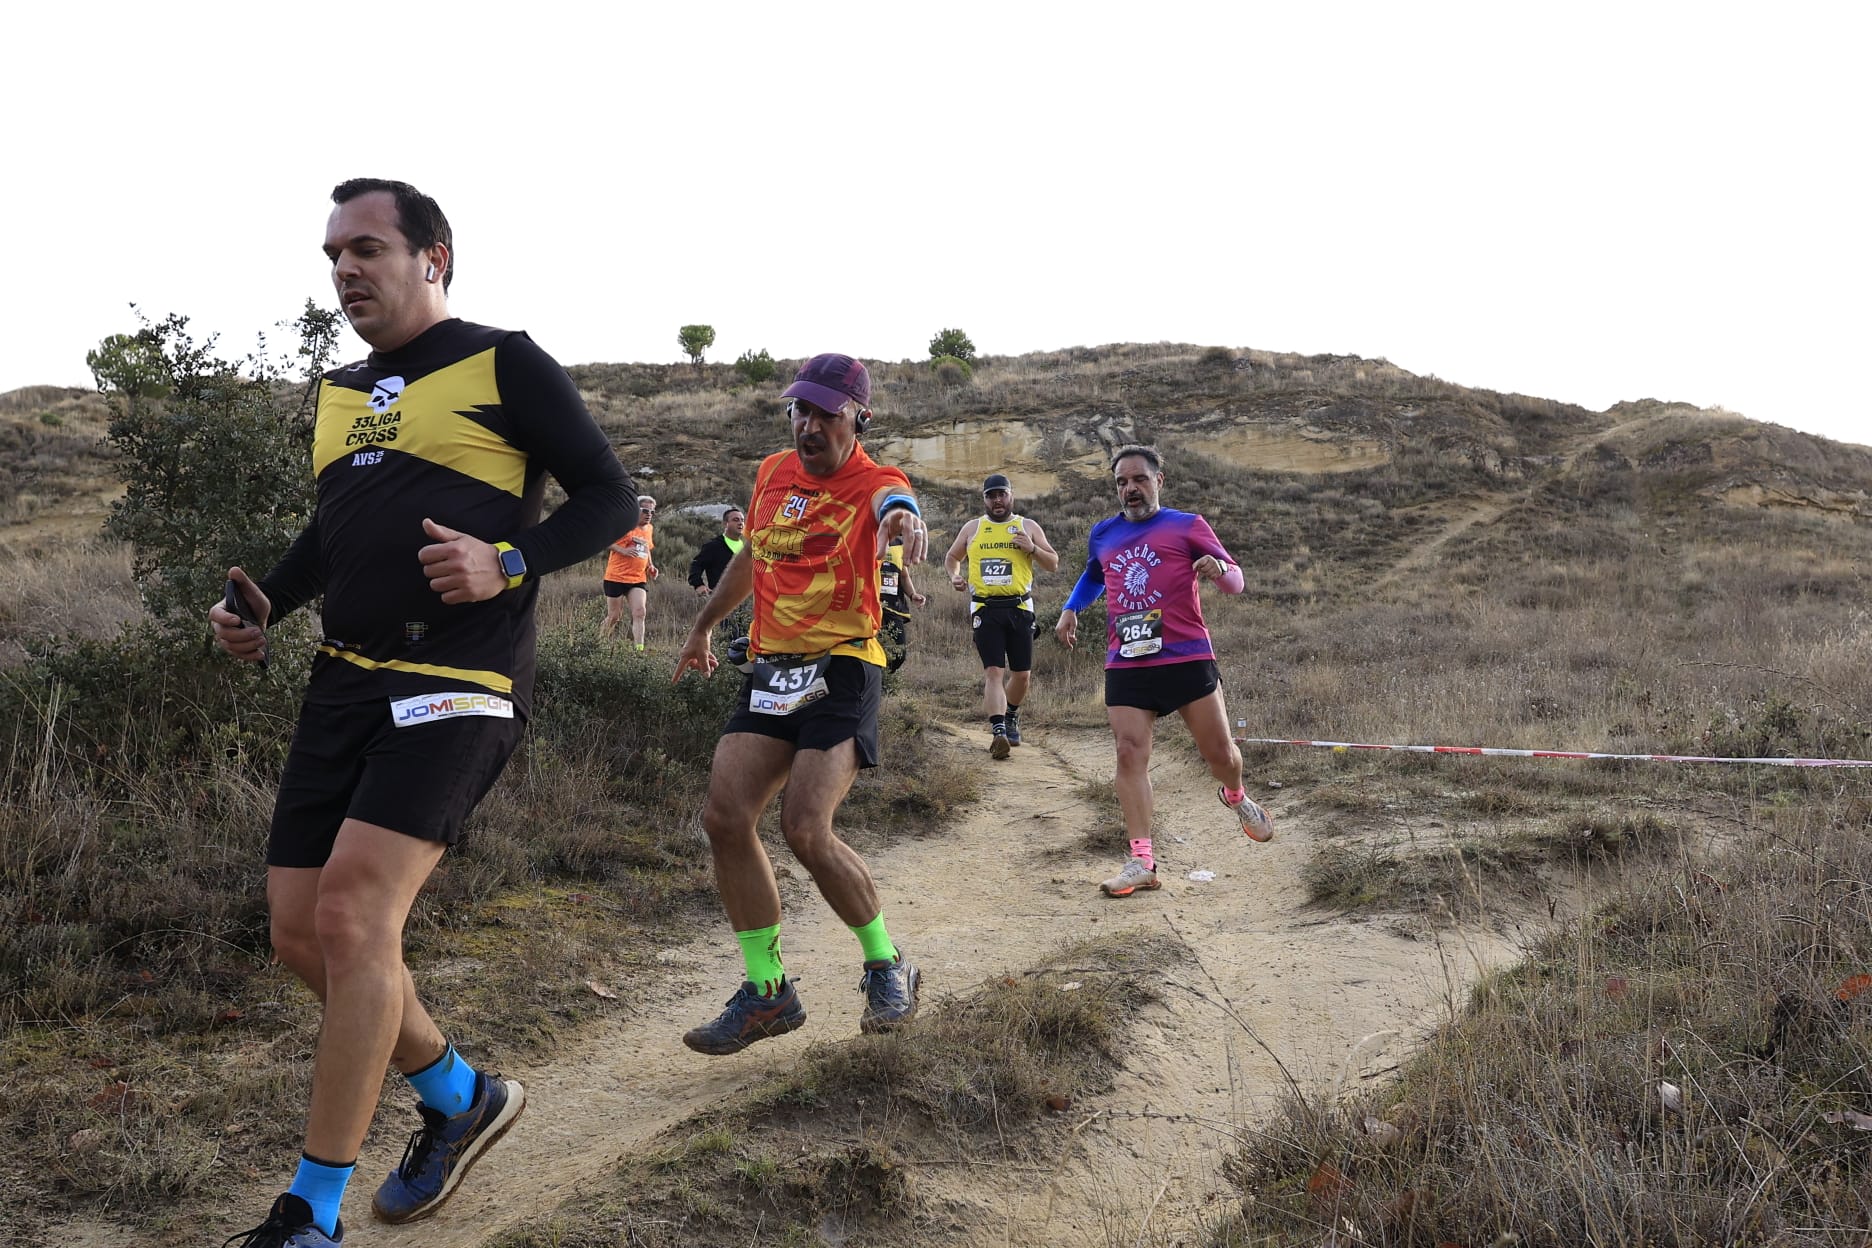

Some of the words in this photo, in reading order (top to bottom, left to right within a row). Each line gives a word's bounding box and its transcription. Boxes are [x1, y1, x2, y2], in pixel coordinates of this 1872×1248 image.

[346, 427, 397, 446] CROSS
[352, 451, 375, 466] AVS
[784, 496, 808, 520] 24
[1110, 544, 1161, 572] Apaches
[985, 565, 1006, 575] 427
[1117, 590, 1162, 610] Running
[1123, 623, 1152, 642] 264
[769, 663, 818, 692] 437
